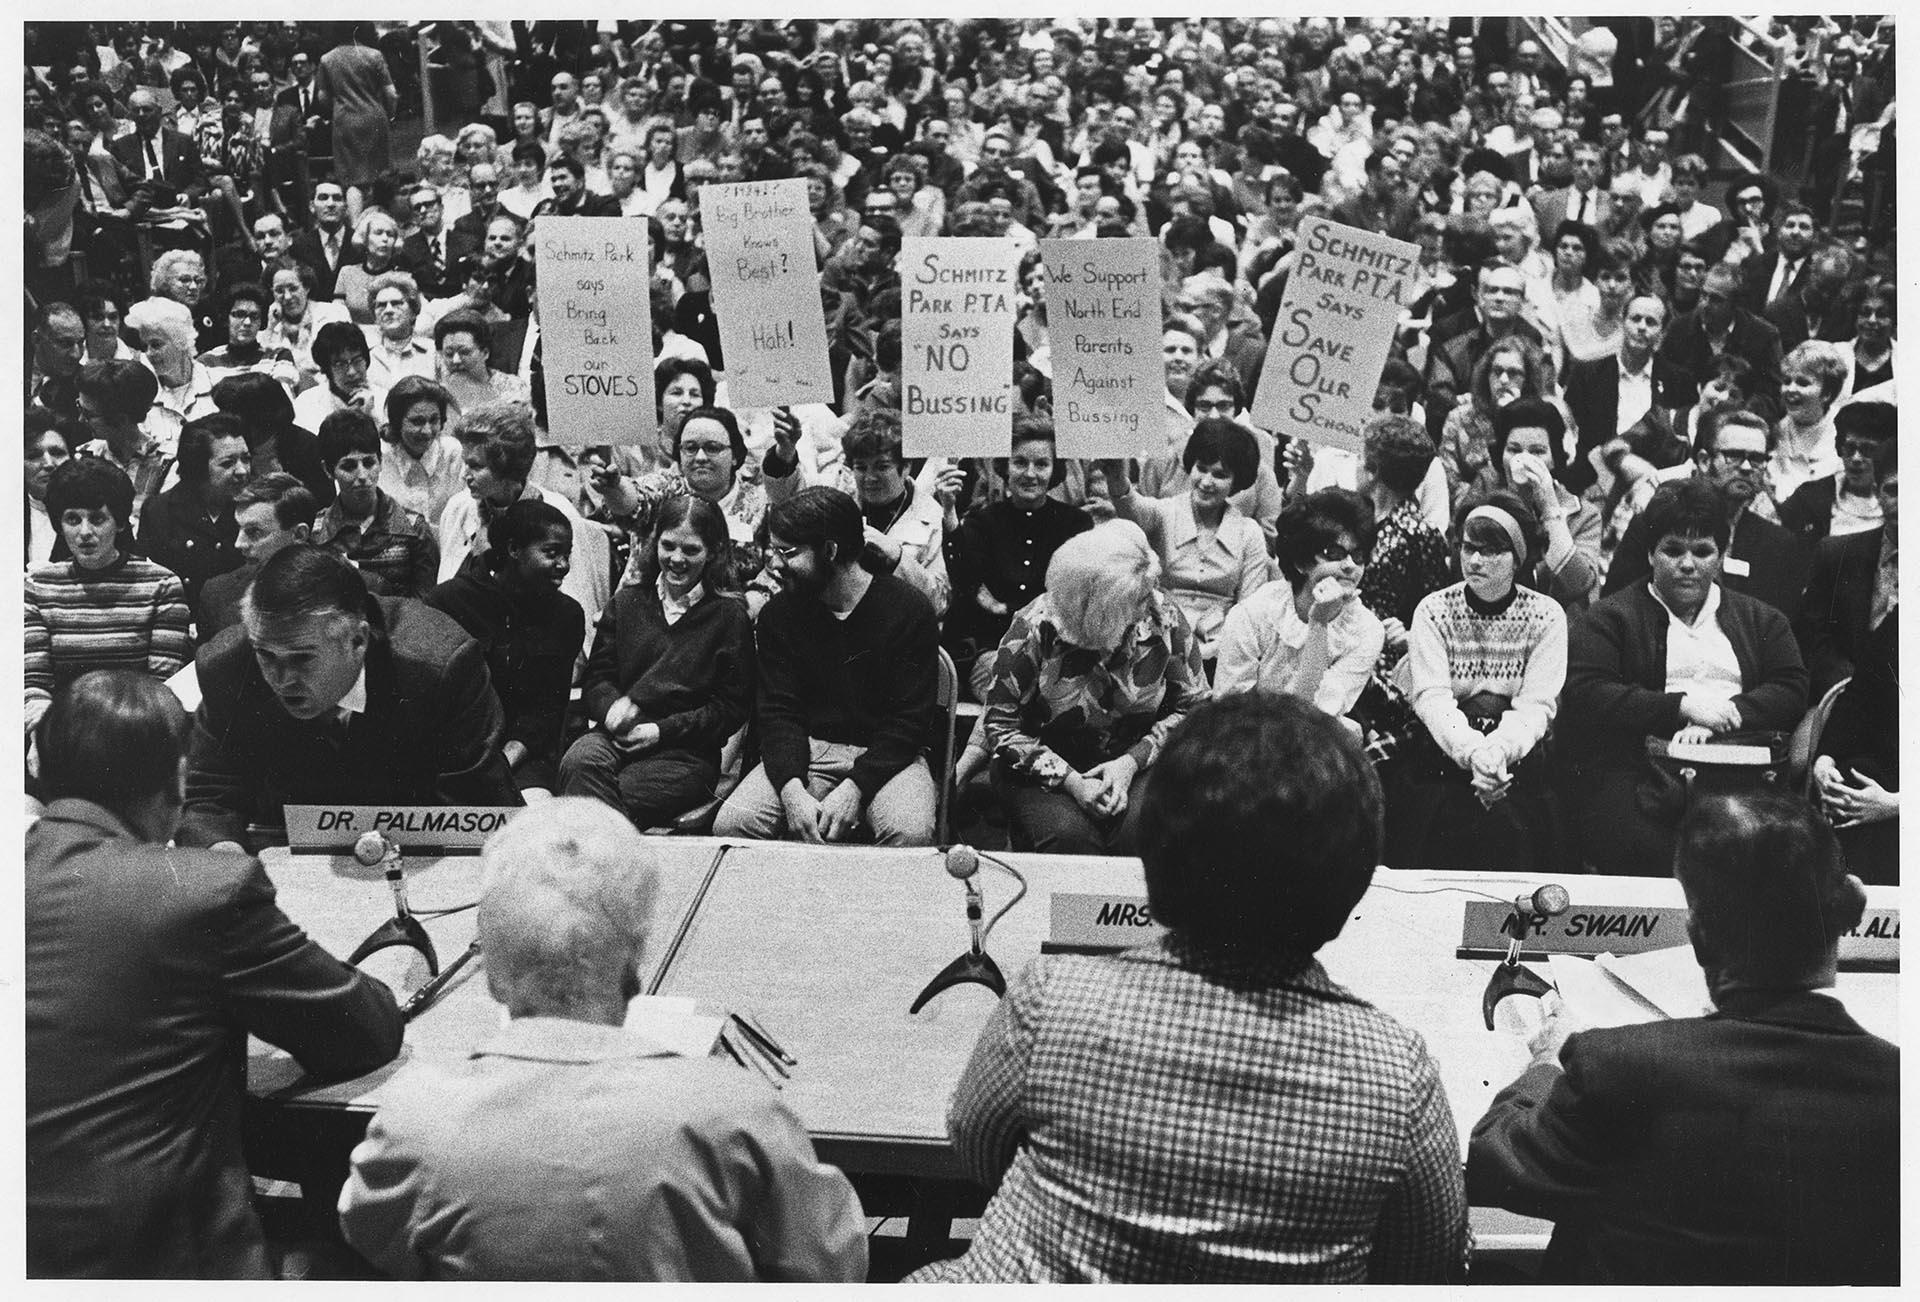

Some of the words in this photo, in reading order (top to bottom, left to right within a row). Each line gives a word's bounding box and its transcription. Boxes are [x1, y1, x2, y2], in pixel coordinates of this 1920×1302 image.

[545, 240, 594, 262] Schmitz
[605, 242, 634, 262] Park
[576, 278, 604, 296] says
[1046, 263, 1073, 284] We
[1083, 262, 1148, 292] Support
[566, 301, 607, 327] Bring
[1065, 299, 1106, 319] North
[1112, 298, 1141, 319] End
[584, 329, 619, 346] Back
[1075, 334, 1133, 355] Parents
[583, 359, 609, 371] our
[564, 374, 639, 397] STOVES
[1070, 366, 1136, 395] Against
[1068, 400, 1140, 432] Bussing
[317, 811, 359, 831] DR.
[1564, 914, 1660, 938] SWAIN
